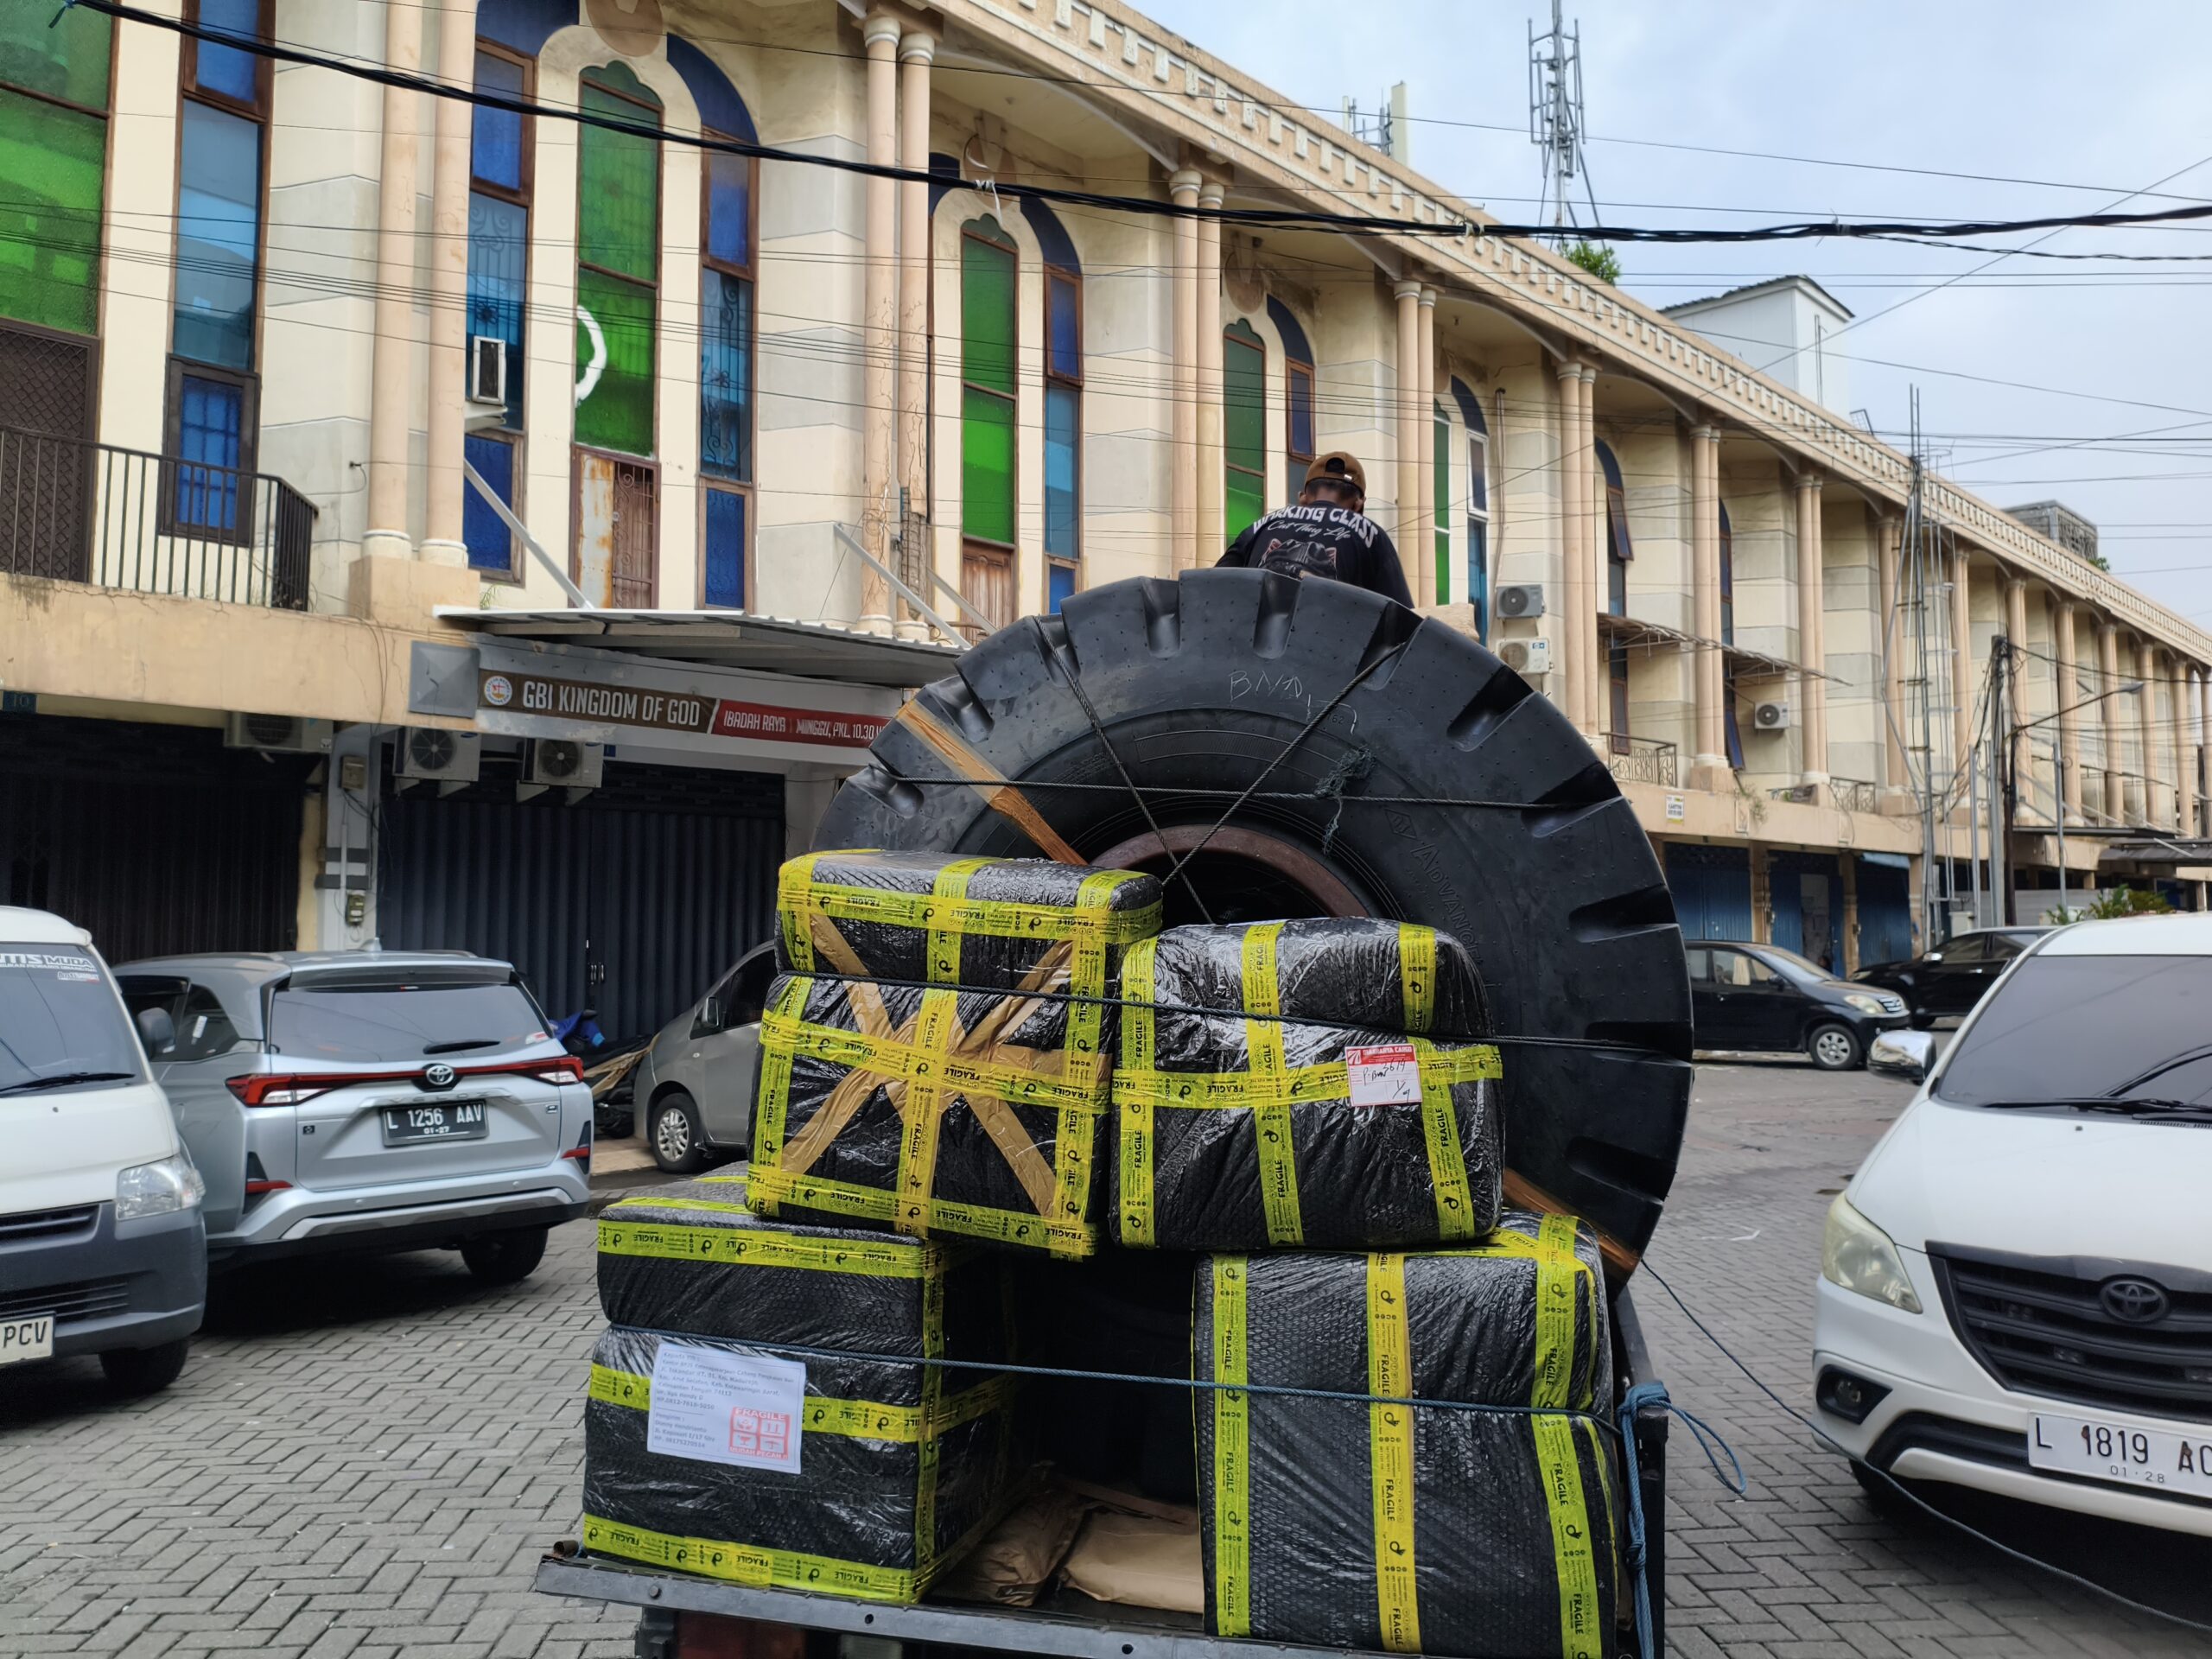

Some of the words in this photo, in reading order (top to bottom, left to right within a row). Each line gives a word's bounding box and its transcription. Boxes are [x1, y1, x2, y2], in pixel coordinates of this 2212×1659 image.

[1268, 520, 1294, 531] Cat
[1294, 523, 1323, 537] Thug
[1324, 527, 1351, 541] Life
[1329, 508, 1379, 549] CLASS
[523, 680, 553, 710] GBI
[559, 685, 638, 720] KINGDOM
[642, 695, 664, 721] OF
[667, 698, 700, 726] GOD
[723, 710, 760, 730] IBADAH
[762, 715, 786, 733] RAYA
[833, 721, 851, 739] PKL.
[852, 724, 874, 740] 10.30
[950, 910, 985, 919] FRAGILE
[1057, 918, 1094, 927] FRAGILE
[46, 955, 92, 967] MUDA
[925, 1012, 938, 1049] FRAGILE
[844, 1042, 877, 1056] FRAGILE
[944, 1068, 981, 1081] FRAGILE
[1052, 1087, 1089, 1099] FRAGILE
[1207, 1084, 1244, 1093] FRAGILE
[390, 1092, 490, 1103] VELOZ
[387, 1111, 398, 1129] L
[408, 1108, 443, 1128] 1256
[456, 1104, 482, 1123] AAV
[423, 1126, 450, 1135] 01-27
[1435, 1107, 1449, 1147] FRAGILE
[911, 1123, 922, 1160] FRAGILE
[1274, 1159, 1286, 1198] FRAGILE
[830, 1192, 864, 1204] FRAGILE
[936, 1211, 972, 1223] FRAGILE
[633, 1234, 664, 1243] FRAGILE
[1045, 1228, 1082, 1240] FRAGILE
[3, 1321, 48, 1348] PCV
[1381, 1354, 1390, 1395] FRAGILE
[1546, 1348, 1557, 1387] FRAGILE
[734, 1408, 785, 1421] FRAGILE
[2036, 1417, 2052, 1449] L
[2081, 1425, 2149, 1465] 1819
[729, 1446, 755, 1455] MUDAH
[1226, 1452, 1235, 1493] FRAGILE
[1554, 1462, 1569, 1506] FRAGILE
[1386, 1479, 1395, 1522] FRAGILE
[610, 1532, 639, 1545] FRAGILE
[737, 1555, 768, 1567] FRAGILE
[835, 1571, 868, 1583] FRAGILE
[1573, 1593, 1584, 1635] FRAGILE
[1393, 1608, 1404, 1646] FRAGILE
